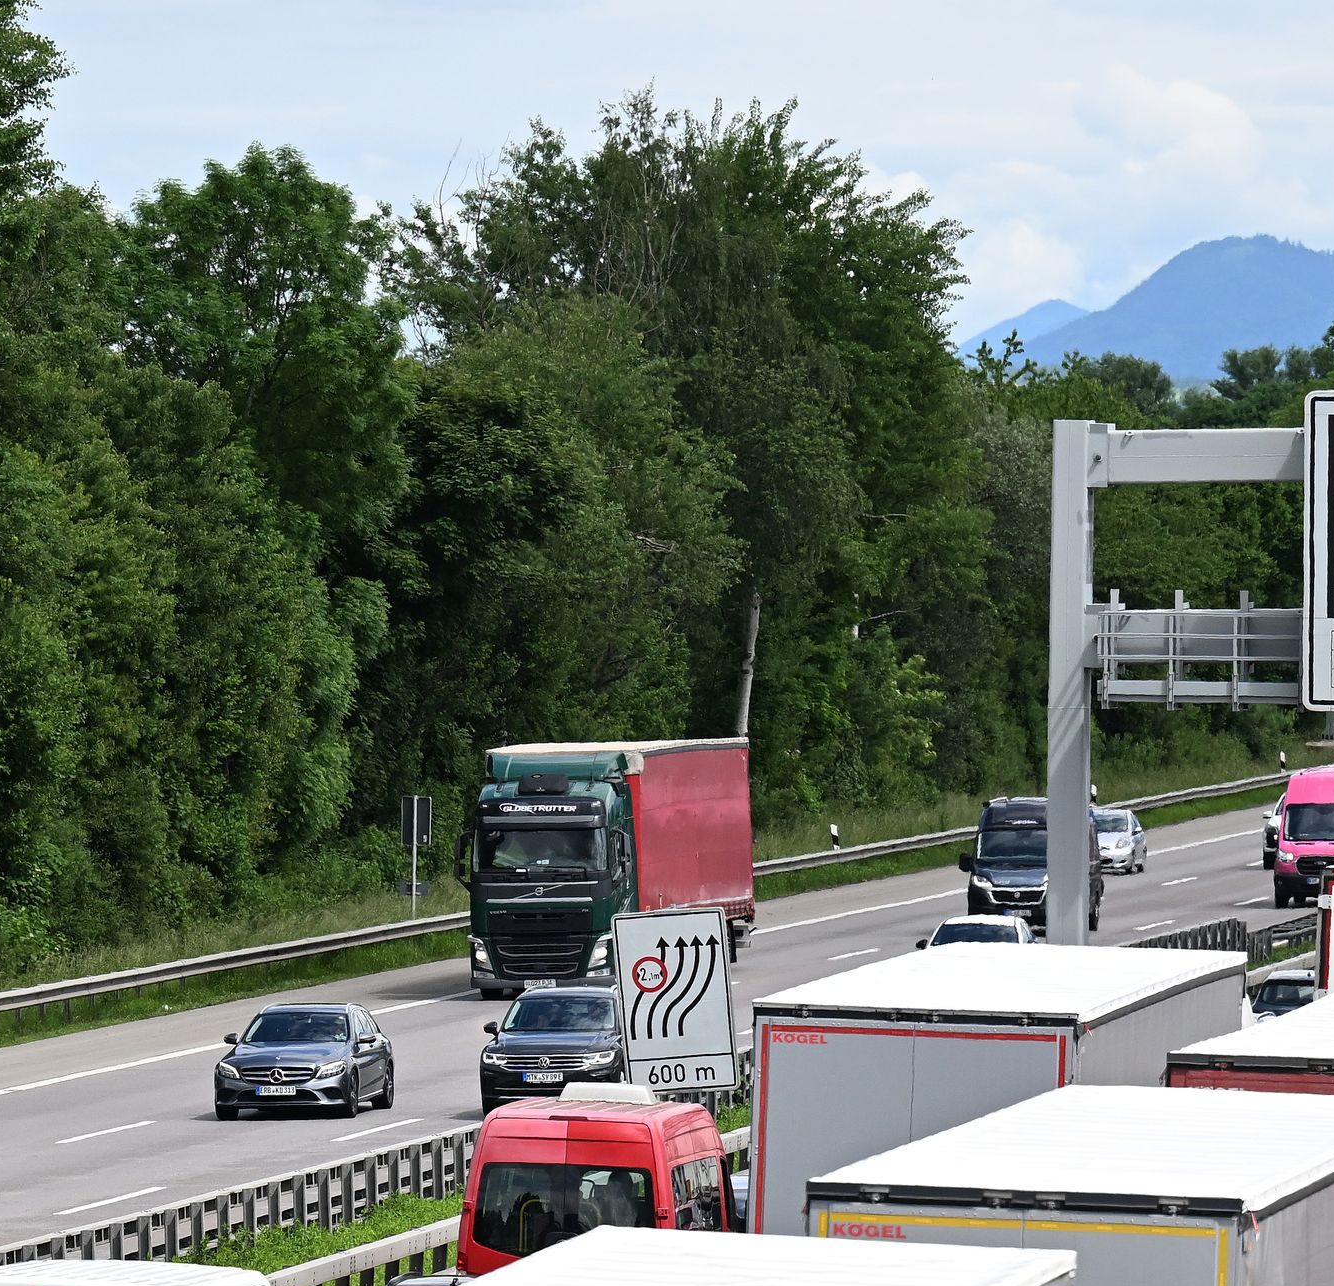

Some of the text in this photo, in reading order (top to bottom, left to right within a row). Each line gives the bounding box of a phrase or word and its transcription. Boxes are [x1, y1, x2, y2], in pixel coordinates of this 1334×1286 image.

[500, 803, 577, 813] GLOBETROTTER
[772, 1032, 827, 1044] KÖGEL
[648, 1064, 716, 1085] 600 m
[833, 1222, 907, 1239] KÖGEL
